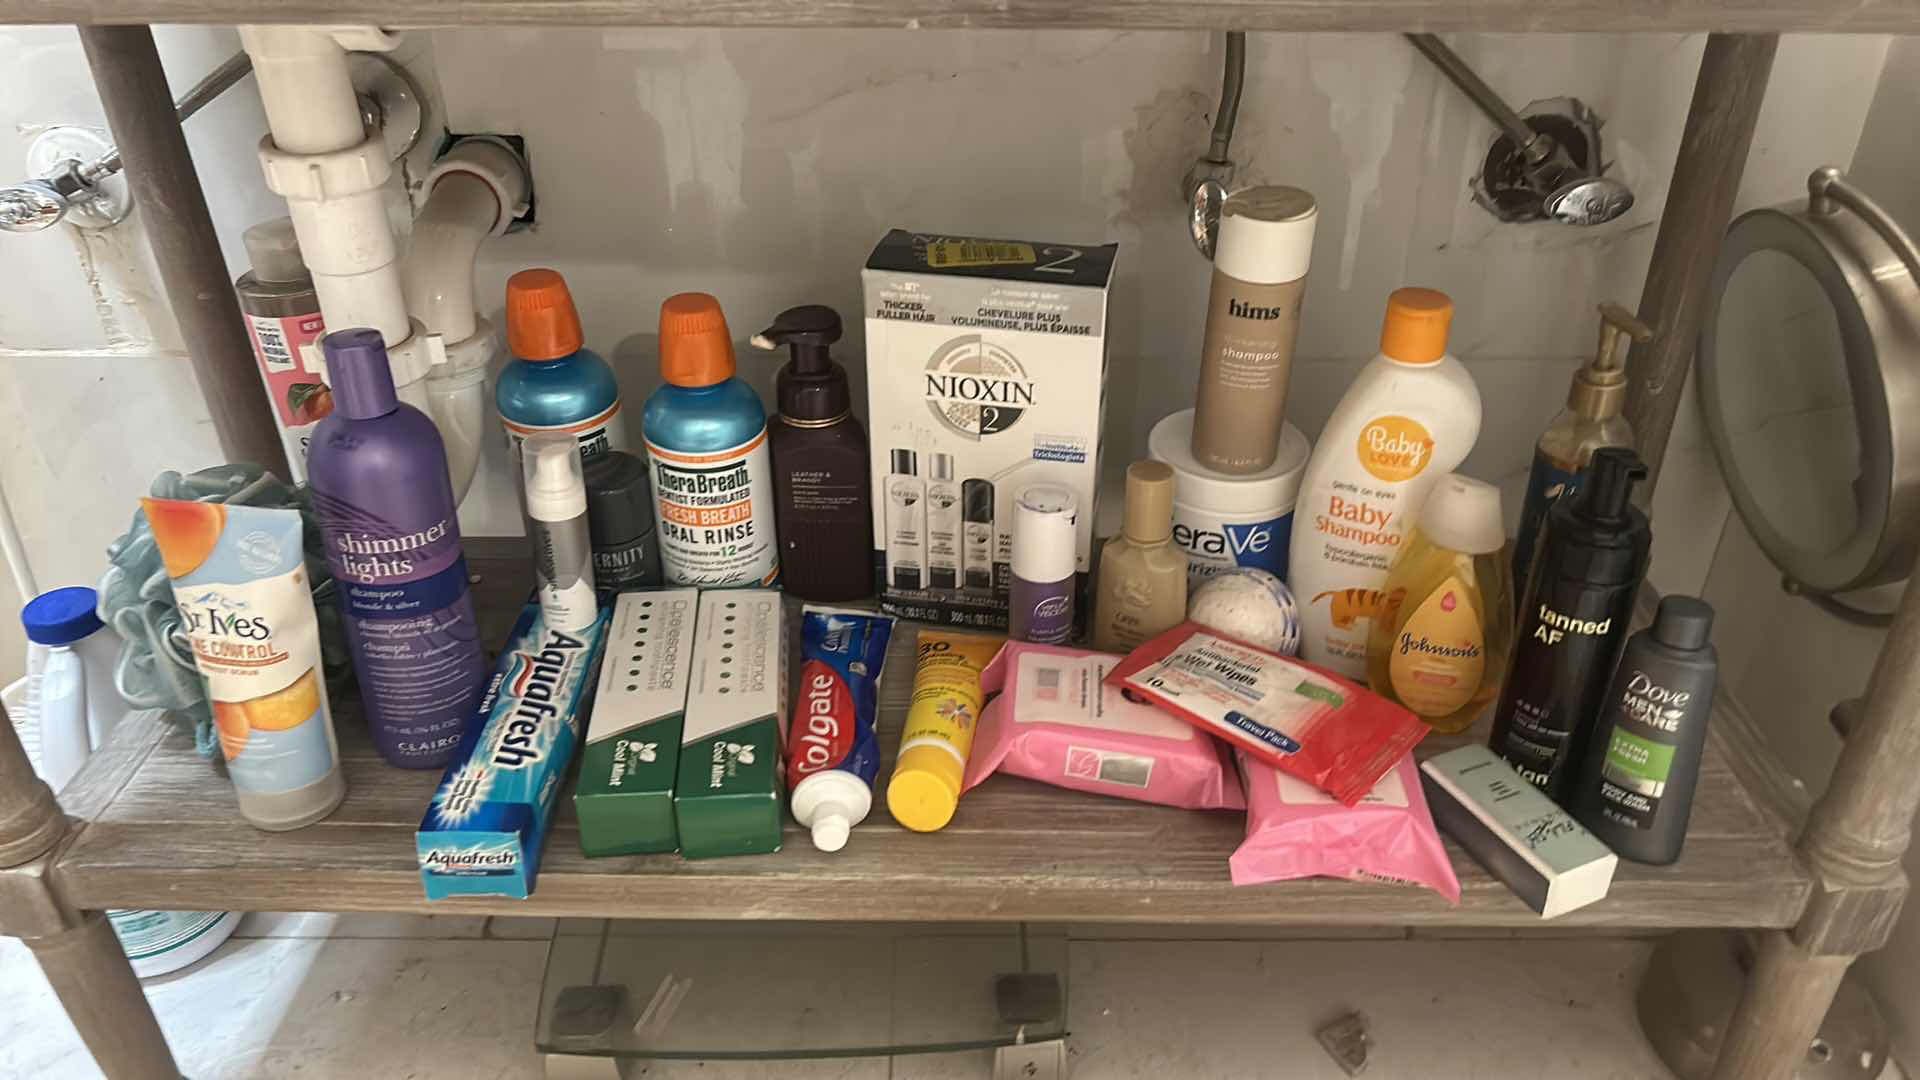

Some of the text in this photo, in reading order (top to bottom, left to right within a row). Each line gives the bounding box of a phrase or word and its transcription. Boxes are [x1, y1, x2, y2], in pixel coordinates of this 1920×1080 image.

[1033, 246, 1083, 274] 2
[876, 309, 910, 320] FULLER
[977, 307, 1062, 323] CHEVELURE PLUS
[1229, 298, 1280, 320] hims
[1023, 322, 1048, 333] PLUS
[1223, 347, 1281, 364] shampoo
[925, 374, 1034, 405] NIOXIN
[983, 406, 999, 431] 2
[1366, 425, 1425, 467] Baby
[657, 462, 751, 494] TheraBreath
[700, 504, 751, 526] BREATH
[1329, 495, 1393, 530] Baby
[337, 519, 446, 554] shimmer
[661, 520, 755, 545] ORAL RINSE
[1172, 523, 1272, 554] eraVe
[1315, 514, 1401, 545] Shampoo
[593, 546, 644, 568] ERNITY
[720, 545, 737, 557] 12
[341, 554, 414, 584] lights
[206, 607, 271, 640] Ives
[1540, 604, 1612, 635] tanned
[919, 639, 950, 656] 30
[1401, 632, 1480, 658] Johnson's
[1534, 624, 1564, 645] AF
[210, 641, 278, 660] CONTROL
[1183, 654, 1258, 687] Wet Wipes
[493, 629, 585, 768] Aquafresh
[1627, 671, 1691, 707] Dove
[1622, 691, 1664, 717] MEN
[798, 674, 839, 773] Colgate
[1237, 715, 1290, 748] Travel Pack
[398, 733, 462, 752] CLAIRO
[426, 850, 515, 867] Aquafresh
